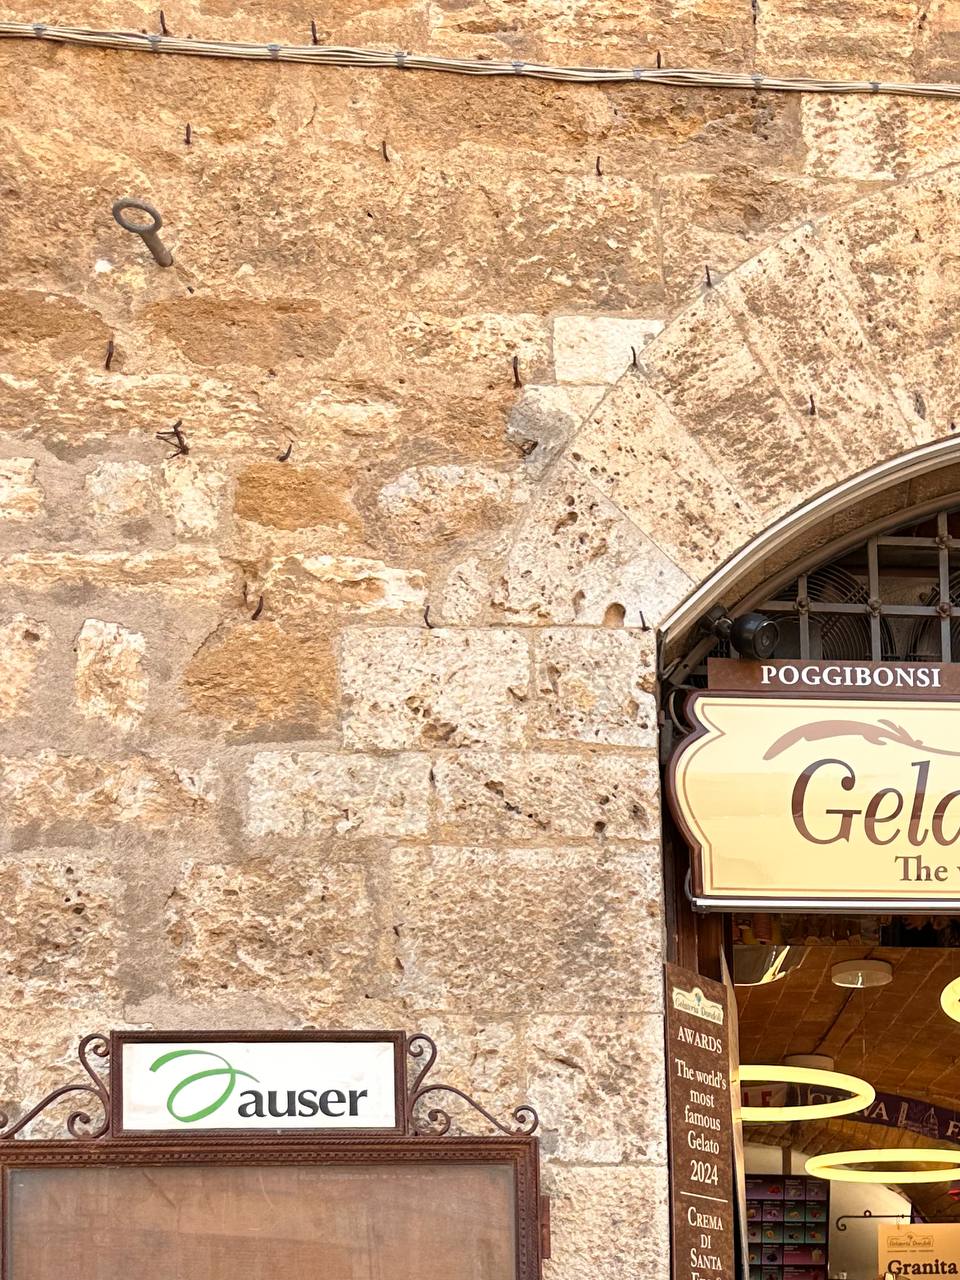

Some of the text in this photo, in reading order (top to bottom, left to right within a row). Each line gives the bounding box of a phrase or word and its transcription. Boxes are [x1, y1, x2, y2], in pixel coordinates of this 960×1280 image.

[761, 665, 941, 688] POGGIBONSI
[894, 855, 948, 883] The
[677, 1026, 722, 1054] AWARDS
[675, 1058, 694, 1080] The
[237, 1089, 368, 1118] auser
[690, 1089, 714, 1108] most
[684, 1105, 721, 1131] famous
[688, 1130, 720, 1155] Gelato
[690, 1159, 719, 1186] 2024
[887, 1259, 958, 1275] Granita
